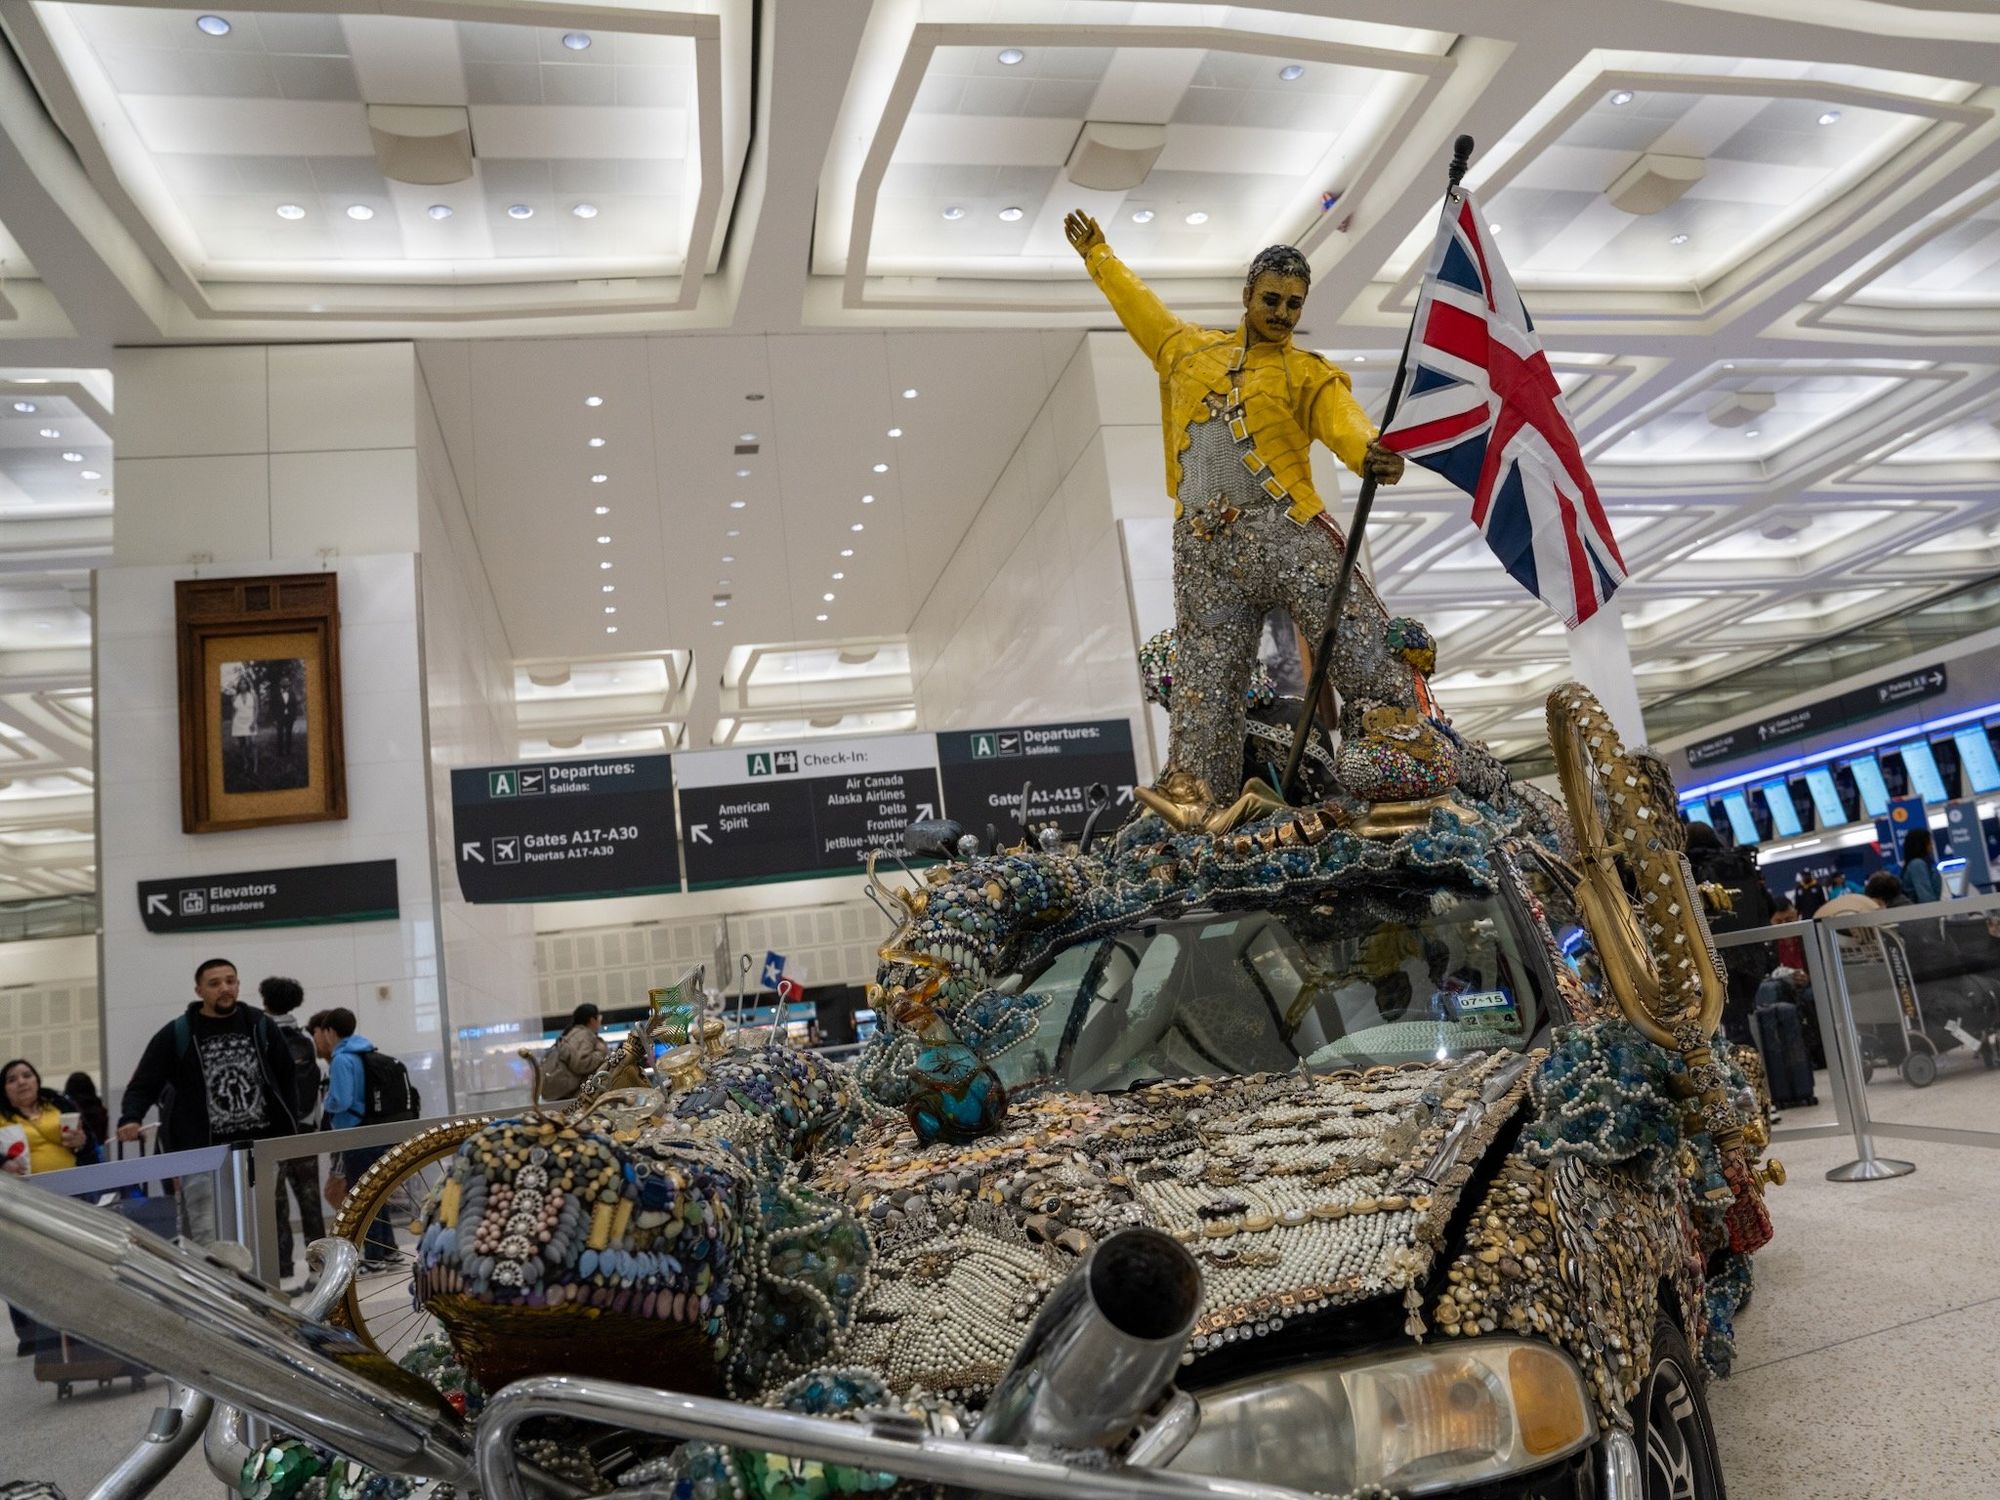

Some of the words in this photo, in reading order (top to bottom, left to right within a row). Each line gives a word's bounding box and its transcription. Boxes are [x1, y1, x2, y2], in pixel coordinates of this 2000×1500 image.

[978, 736, 991, 756] A
[1024, 727, 1100, 744] Departures:
[1025, 744, 1061, 756] Salidas:
[753, 755, 767, 775] A
[803, 752, 868, 767] Check-In:
[496, 775, 511, 794] A
[550, 763, 635, 781] Departures:
[846, 780, 861, 790] Air
[864, 774, 904, 788] Canada
[550, 782, 590, 794] Salidas:
[1031, 786, 1082, 803] A1-A15
[828, 792, 862, 806] Alaska
[866, 790, 906, 802] Airlines
[719, 801, 770, 816] American
[879, 803, 907, 815] Delta
[1010, 807, 1047, 819] Prtas
[1048, 802, 1083, 815] A1-A15
[720, 817, 749, 832] Spirit
[867, 817, 908, 831] Frontier
[524, 834, 567, 848] Gates
[572, 825, 639, 845] A17-A30
[524, 850, 565, 863] Puertas
[567, 845, 614, 860] A17-A30
[210, 883, 277, 901] Elevators
[210, 900, 265, 914] Elevadores
